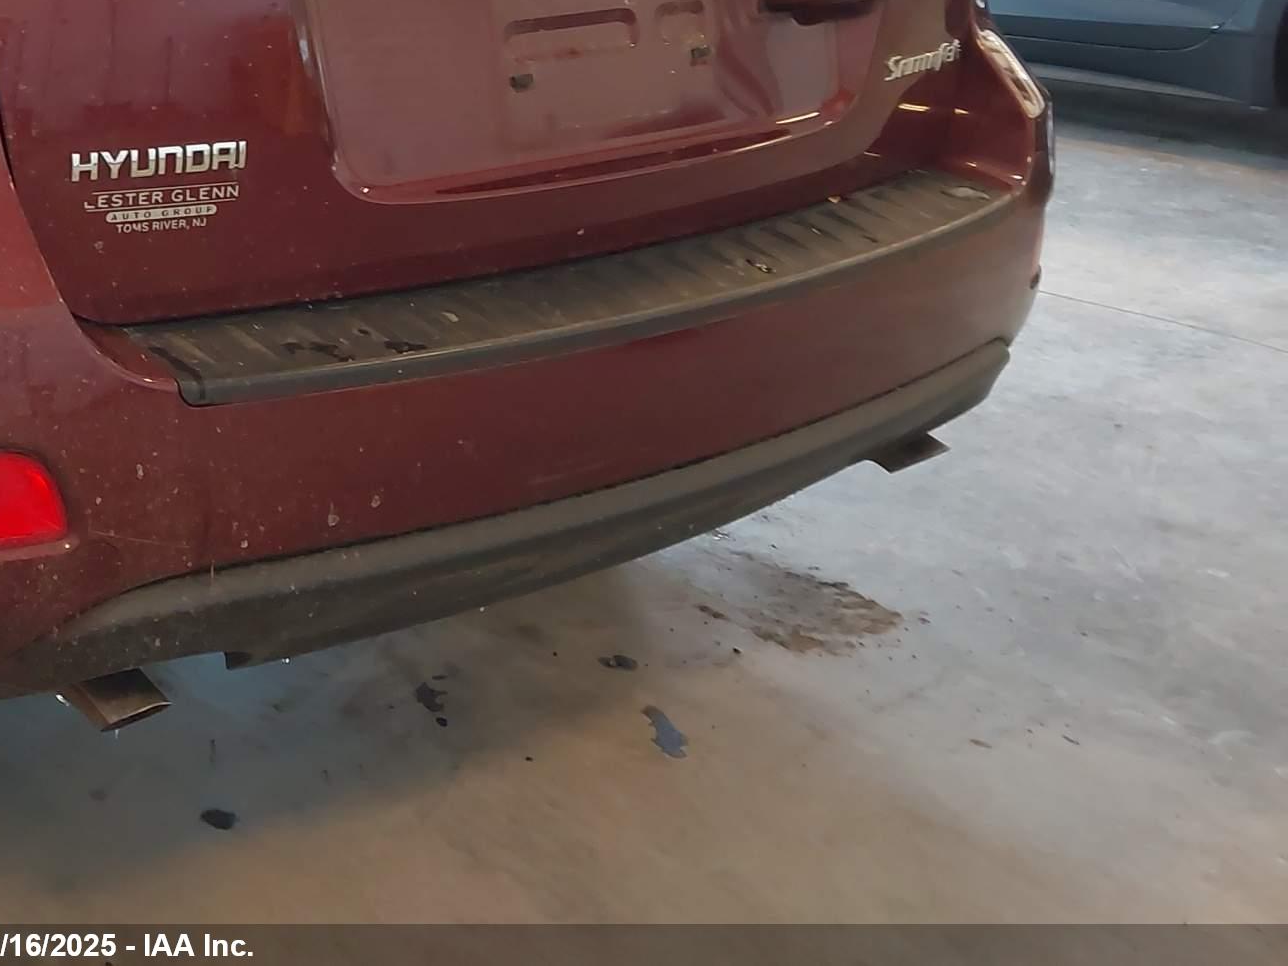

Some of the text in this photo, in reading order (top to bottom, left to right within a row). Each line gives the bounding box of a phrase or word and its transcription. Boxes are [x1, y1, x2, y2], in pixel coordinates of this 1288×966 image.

[71, 140, 247, 182] HYUNDAI
[83, 185, 240, 209] LESTER GLENN
[111, 211, 152, 222] AUTO
[115, 217, 207, 234] TOMS RIVER, NJ
